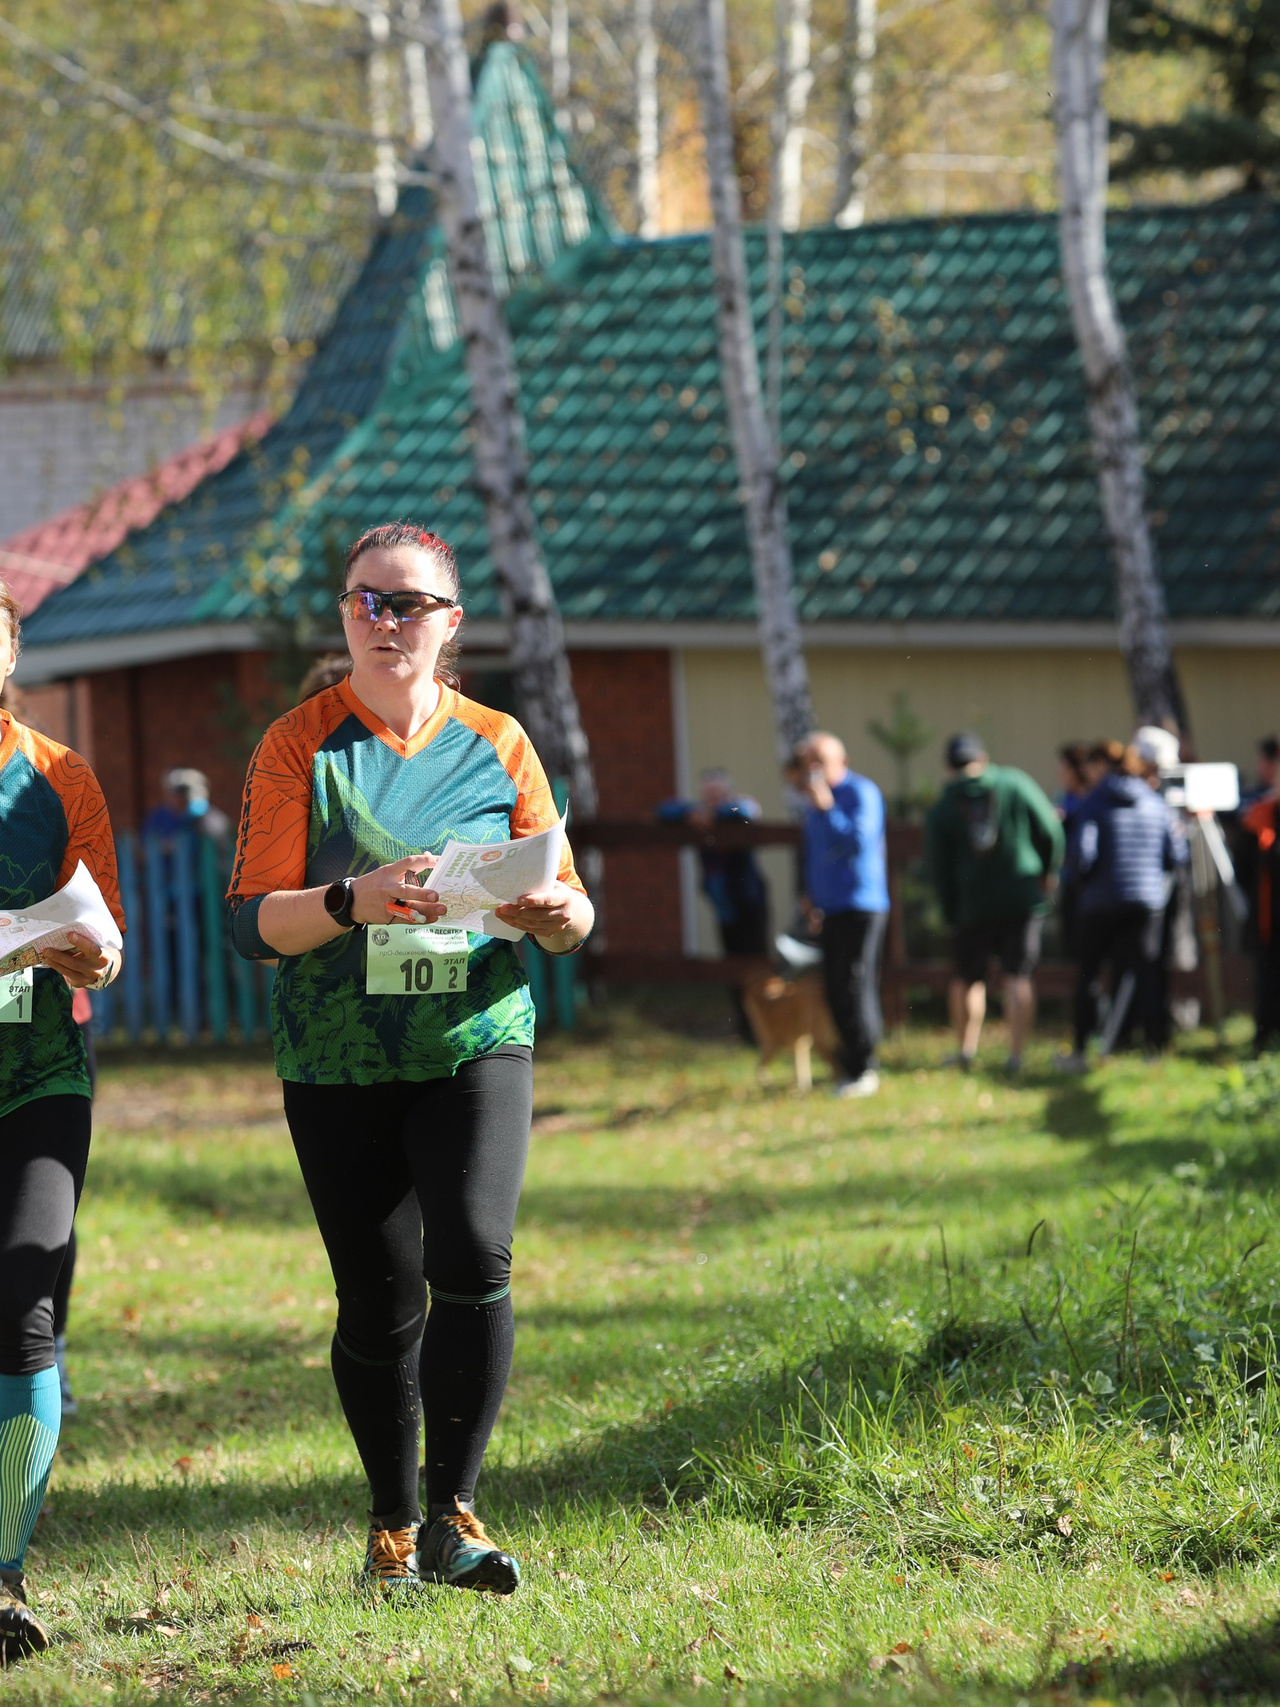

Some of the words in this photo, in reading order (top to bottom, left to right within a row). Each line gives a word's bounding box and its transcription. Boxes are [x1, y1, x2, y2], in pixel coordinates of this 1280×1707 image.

[380, 949, 426, 957] прО-движение
[400, 958, 433, 992] 10
[448, 966, 458, 989] 2
[9, 985, 31, 993] ЭТАП
[16, 994, 23, 1019] 1
